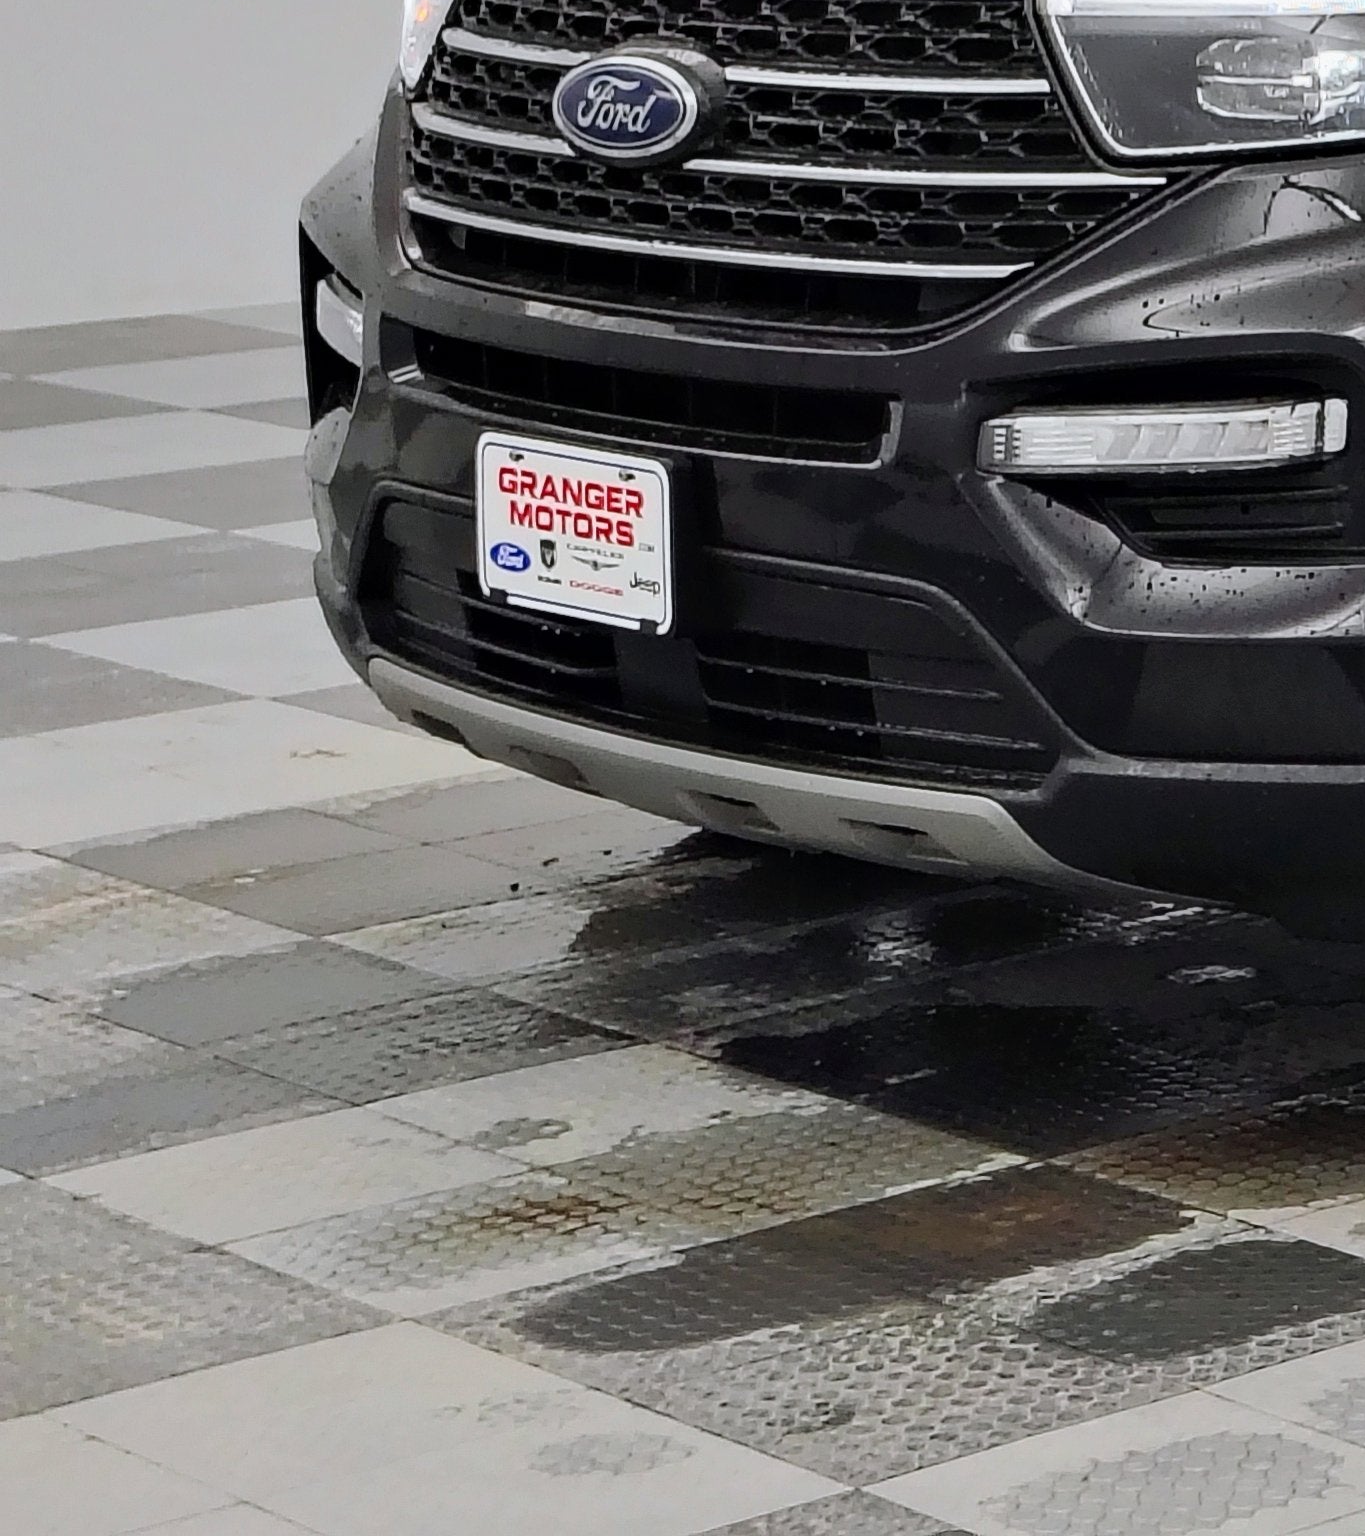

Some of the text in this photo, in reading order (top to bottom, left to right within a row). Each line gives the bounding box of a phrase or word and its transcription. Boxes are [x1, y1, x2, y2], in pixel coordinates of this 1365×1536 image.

[576, 74, 657, 134] Ford
[498, 466, 645, 518] GRANGER
[509, 499, 634, 547] MOTORS
[629, 571, 661, 595] Jeep
